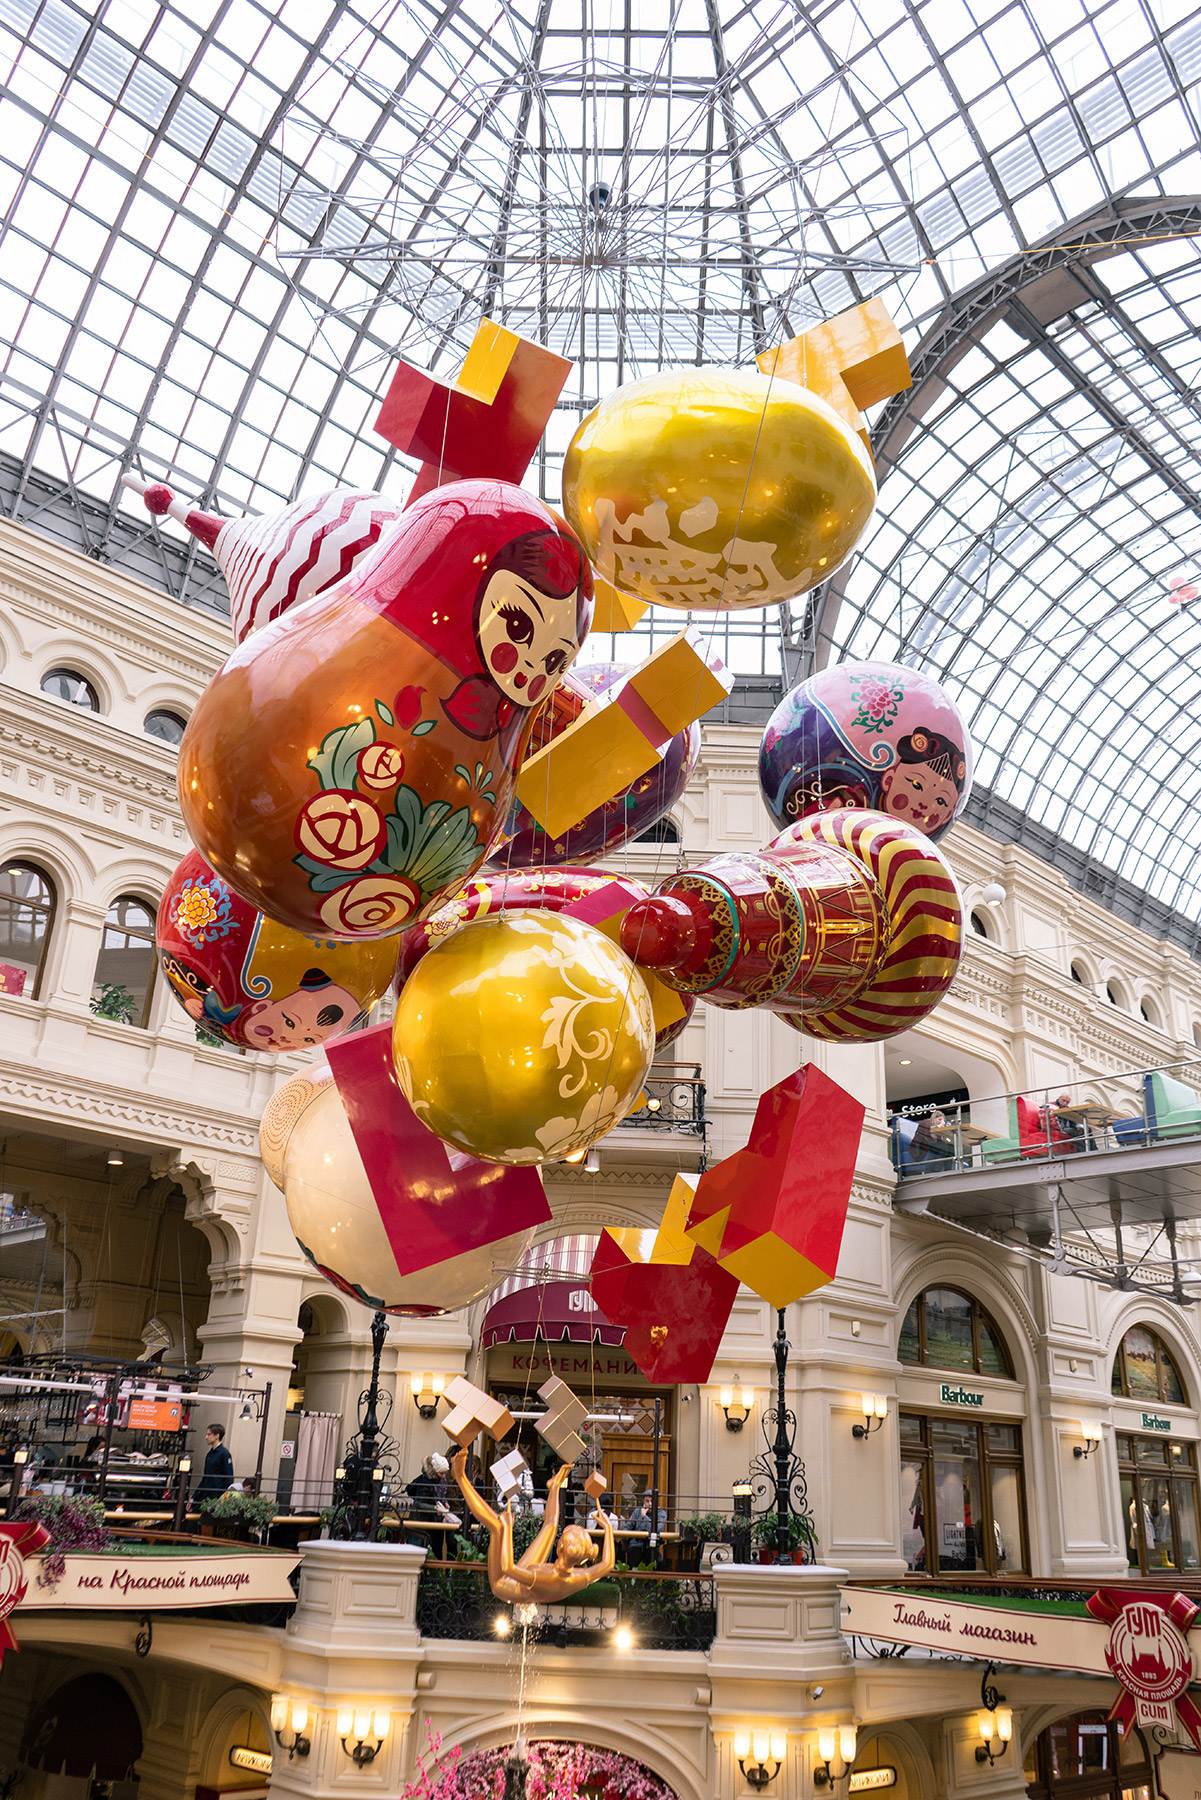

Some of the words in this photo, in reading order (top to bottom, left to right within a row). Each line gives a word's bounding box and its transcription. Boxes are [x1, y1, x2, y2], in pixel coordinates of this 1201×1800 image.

[901, 1103, 937, 1118] Store
[568, 1289, 599, 1313] ГУМ
[512, 1355, 639, 1375] КОФЕМАНИ
[941, 1384, 984, 1406] Barbour
[1141, 1413, 1171, 1431] Barbour
[77, 1575, 103, 1589] на
[109, 1569, 185, 1595] Красной
[189, 1571, 250, 1590] площади
[893, 1603, 952, 1633] Главный
[959, 1622, 1038, 1646] магазин
[1125, 1606, 1161, 1638] ГУМ
[1116, 1669, 1149, 1700] КРАСНАЯ
[1151, 1676, 1183, 1700] ПЛОЩАДЬ
[1140, 1703, 1168, 1720] GUM
